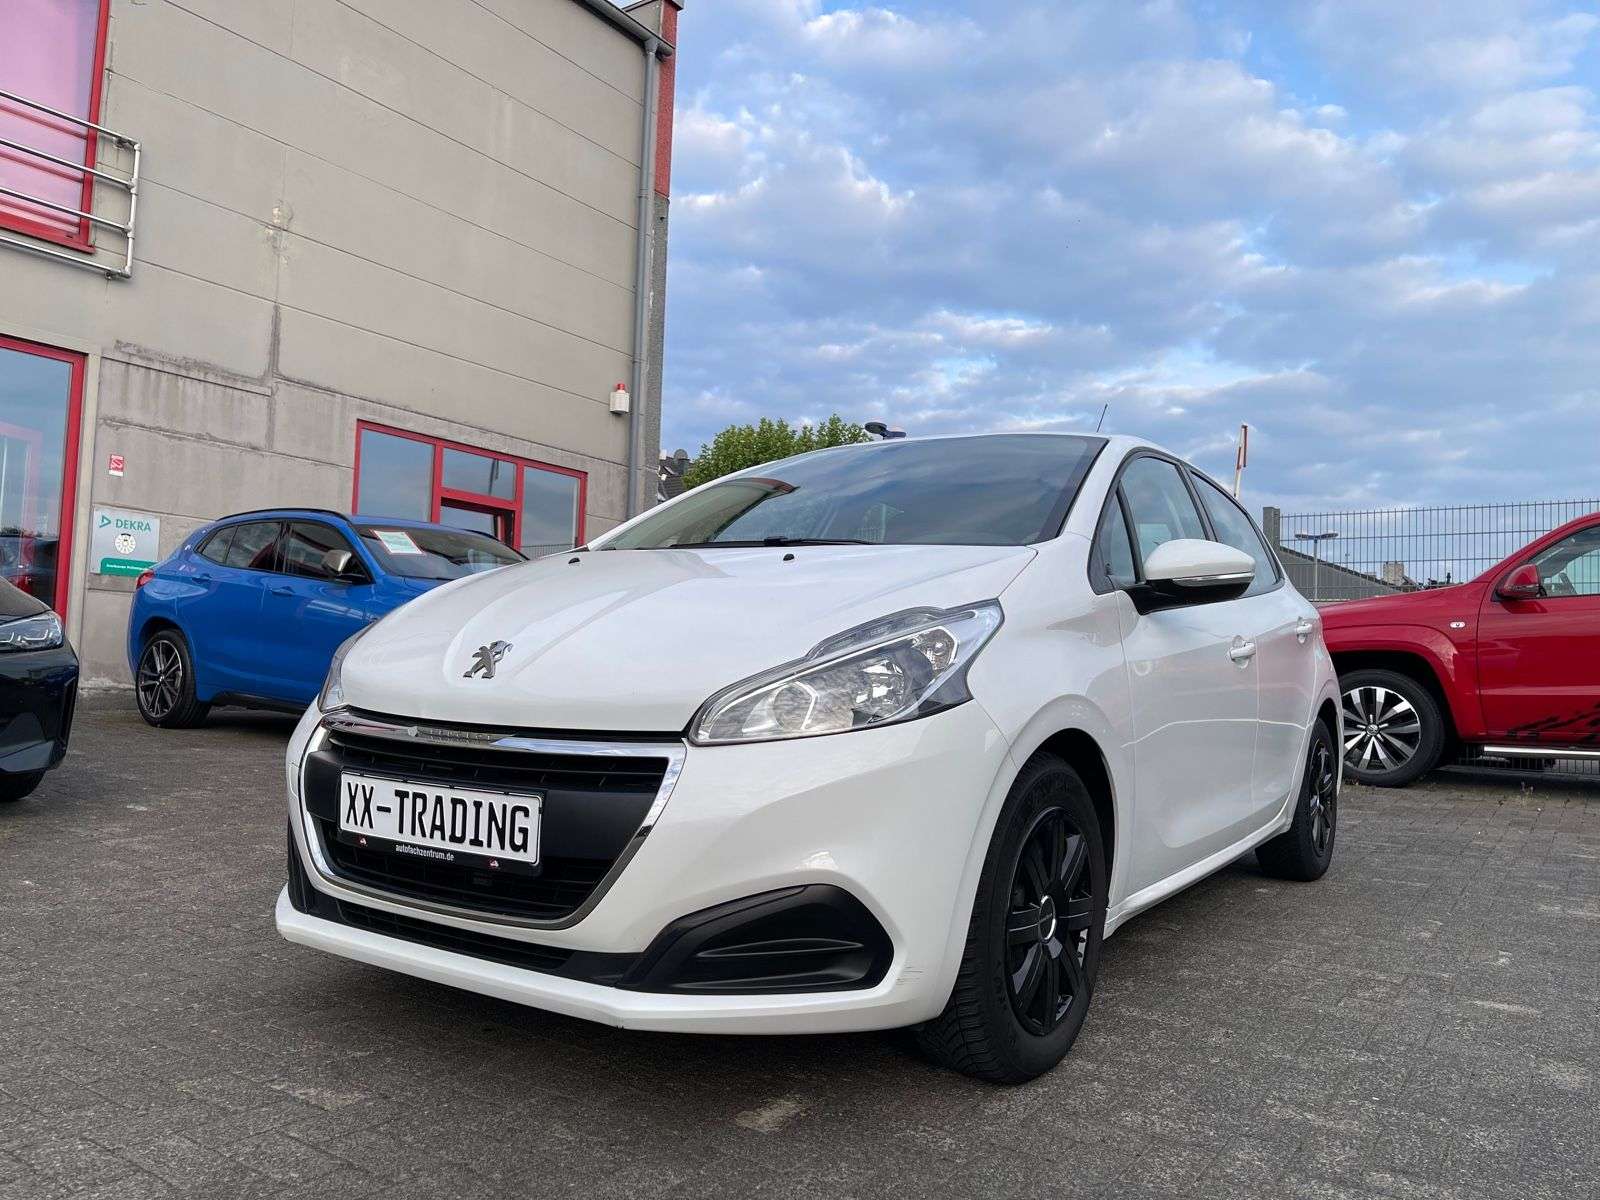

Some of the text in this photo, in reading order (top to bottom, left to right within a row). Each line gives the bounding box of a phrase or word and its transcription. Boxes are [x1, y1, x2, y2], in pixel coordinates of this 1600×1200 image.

[115, 518, 152, 532] DEKRA
[346, 781, 530, 853] XX-TRADING
[395, 844, 454, 861] autofachzentrum.de
